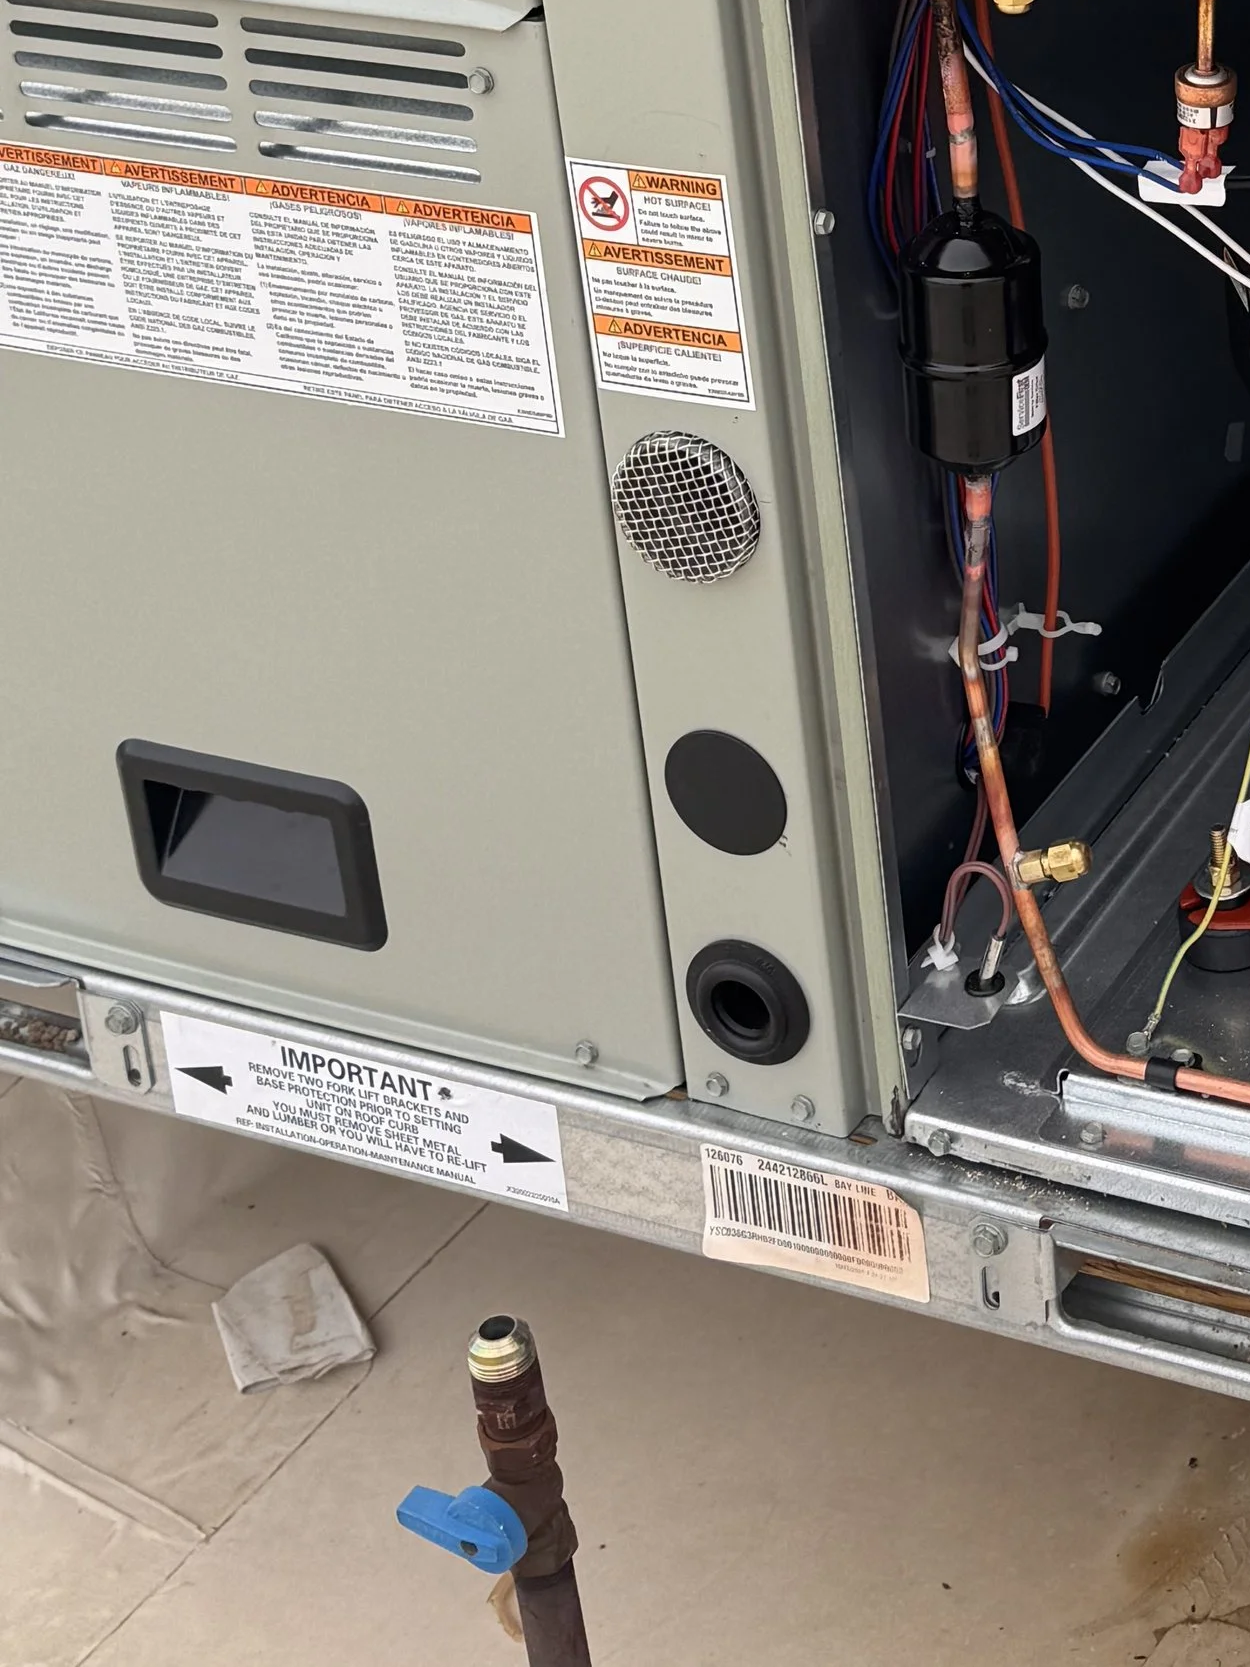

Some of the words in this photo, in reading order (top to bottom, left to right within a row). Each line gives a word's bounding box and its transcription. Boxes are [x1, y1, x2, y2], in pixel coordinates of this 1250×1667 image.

[125, 164, 236, 189] AVERTISSEMENT
[645, 176, 717, 196] WARNING
[271, 184, 371, 209] ADVERTENCIA
[643, 195, 662, 205] HOT
[413, 203, 516, 229] ADVERTENCIA
[603, 245, 724, 272] AVERTISSEMENT
[616, 266, 659, 280] SURFACE
[623, 322, 728, 347] ADVERTENCIA
[280, 1045, 432, 1101] IMPORTANT
[248, 1062, 295, 1082] REMOVE
[297, 1073, 324, 1089] TWO
[326, 1080, 355, 1096] FORK
[358, 1088, 379, 1102] LIFT
[383, 1094, 441, 1118] BRACKETS
[445, 1110, 469, 1125] AND
[256, 1075, 285, 1091] BASE
[288, 1083, 357, 1109] PROTECTION
[359, 1100, 392, 1117] PRIOR
[395, 1109, 411, 1122] TO
[414, 1114, 462, 1135] SETTING
[272, 1100, 296, 1114] YOU
[299, 1107, 331, 1124] MUST
[334, 1115, 382, 1137] REMOVE
[384, 1128, 419, 1146] SHEET
[422, 1137, 462, 1157] METAL
[305, 1098, 332, 1114] UNIT
[335, 1106, 353, 1119] ON
[355, 1110, 386, 1126] ROOF
[388, 1119, 419, 1134] CURB
[246, 1104, 269, 1118] AND
[272, 1111, 319, 1133] LUMBER
[321, 1123, 337, 1135] OR
[339, 1128, 363, 1143] YOU
[366, 1135, 393, 1150] WILL
[395, 1141, 426, 1158] HAVE
[428, 1149, 445, 1163] TO
[447, 1153, 487, 1174] RE-LIFT
[255, 1121, 434, 1174] INSTALLATION-OPERATION-MAINTENANCE
[436, 1167, 476, 1185] MANUAL
[705, 1147, 744, 1166] 126076
[834, 1179, 852, 1192] BAY
